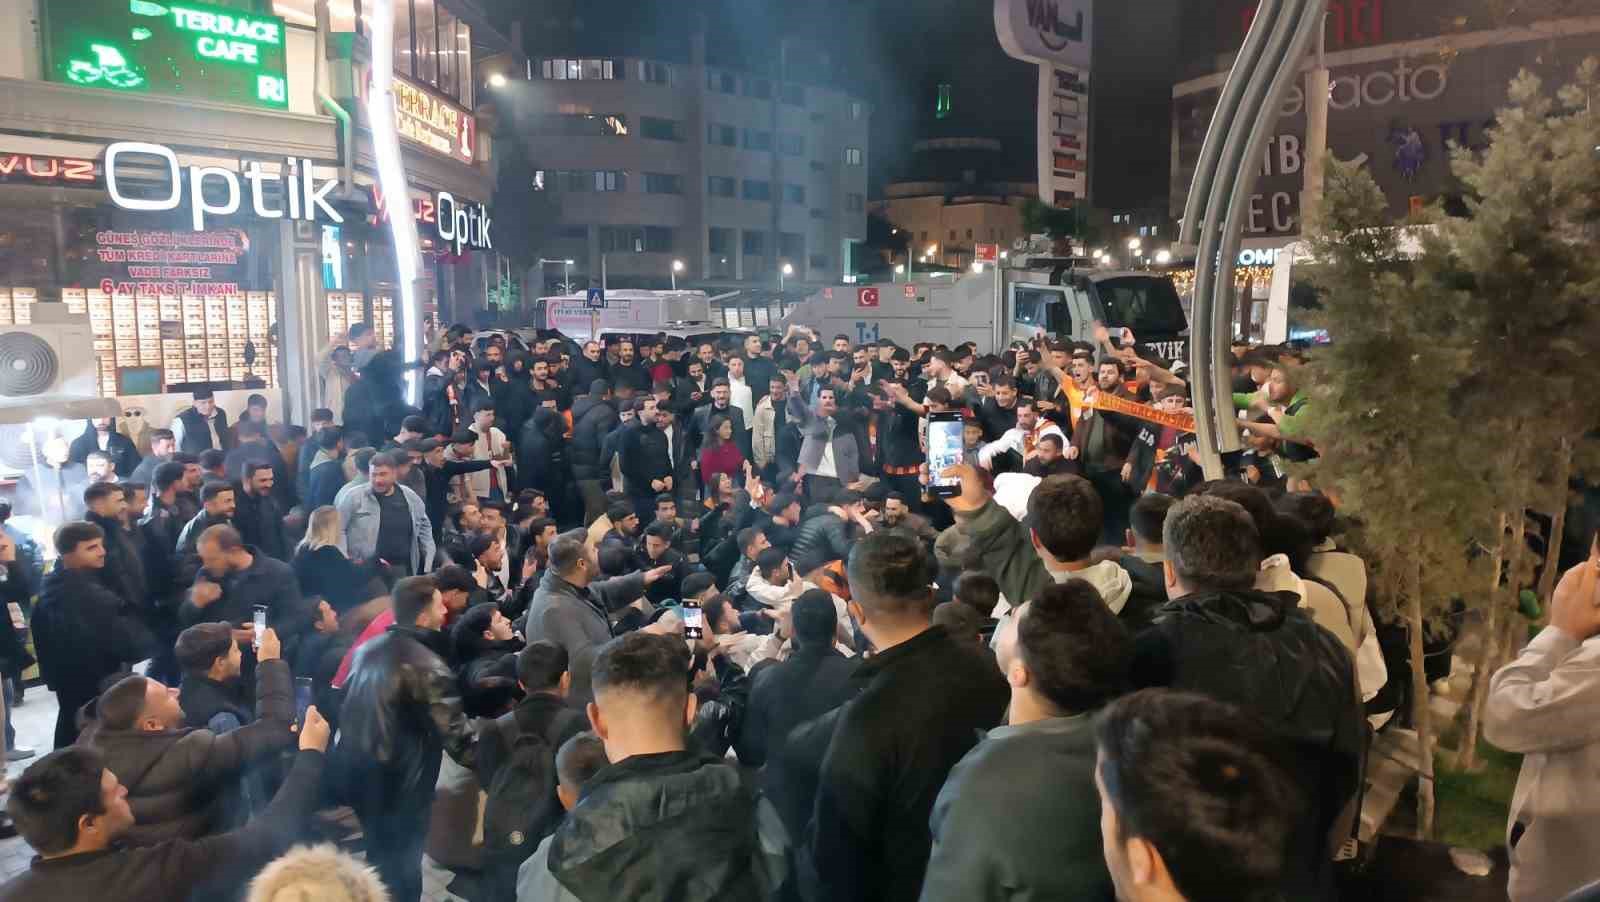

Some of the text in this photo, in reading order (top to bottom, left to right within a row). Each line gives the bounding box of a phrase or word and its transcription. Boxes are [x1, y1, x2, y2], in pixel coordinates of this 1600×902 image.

[170, 6, 279, 43] TERRACE
[197, 37, 259, 64] CAFE
[394, 80, 458, 138] ERRACE
[105, 142, 344, 231] Optik
[438, 191, 492, 256] Optik
[97, 247, 125, 262] TÜM
[101, 277, 115, 296] 6
[117, 282, 136, 296] AY
[139, 280, 188, 296] TAKSİT
[128, 266, 211, 279] VADE FARKSIZ
